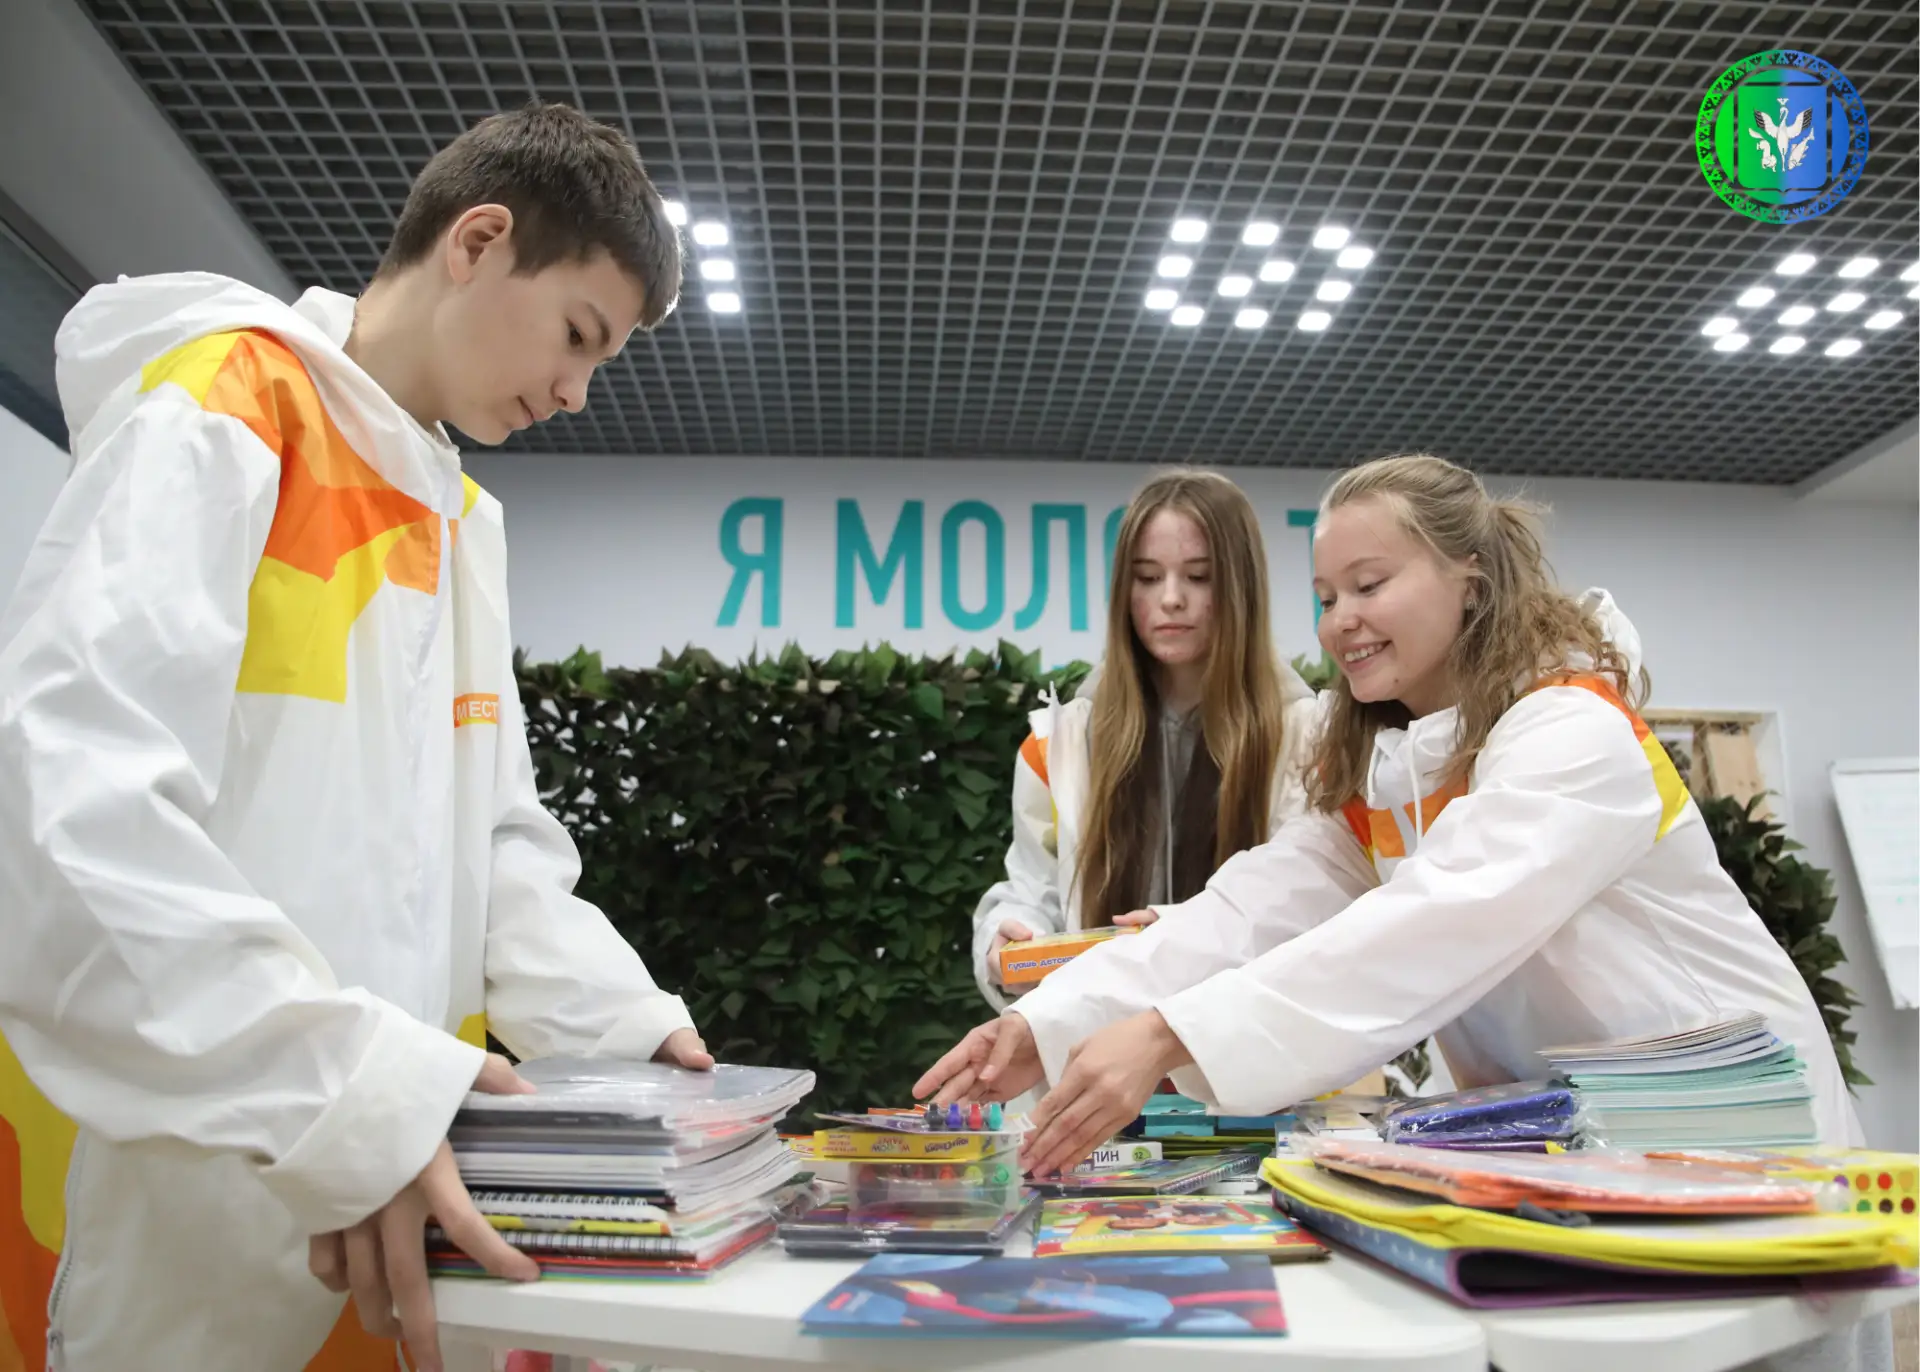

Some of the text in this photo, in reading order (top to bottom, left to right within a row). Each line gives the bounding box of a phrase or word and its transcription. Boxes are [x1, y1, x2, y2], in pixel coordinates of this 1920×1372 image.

[716, 497, 784, 628] Я
[834, 498, 1129, 631] МОЛ
[455, 700, 499, 721] МЕСТ
[1134, 1151, 1144, 1159] 12
